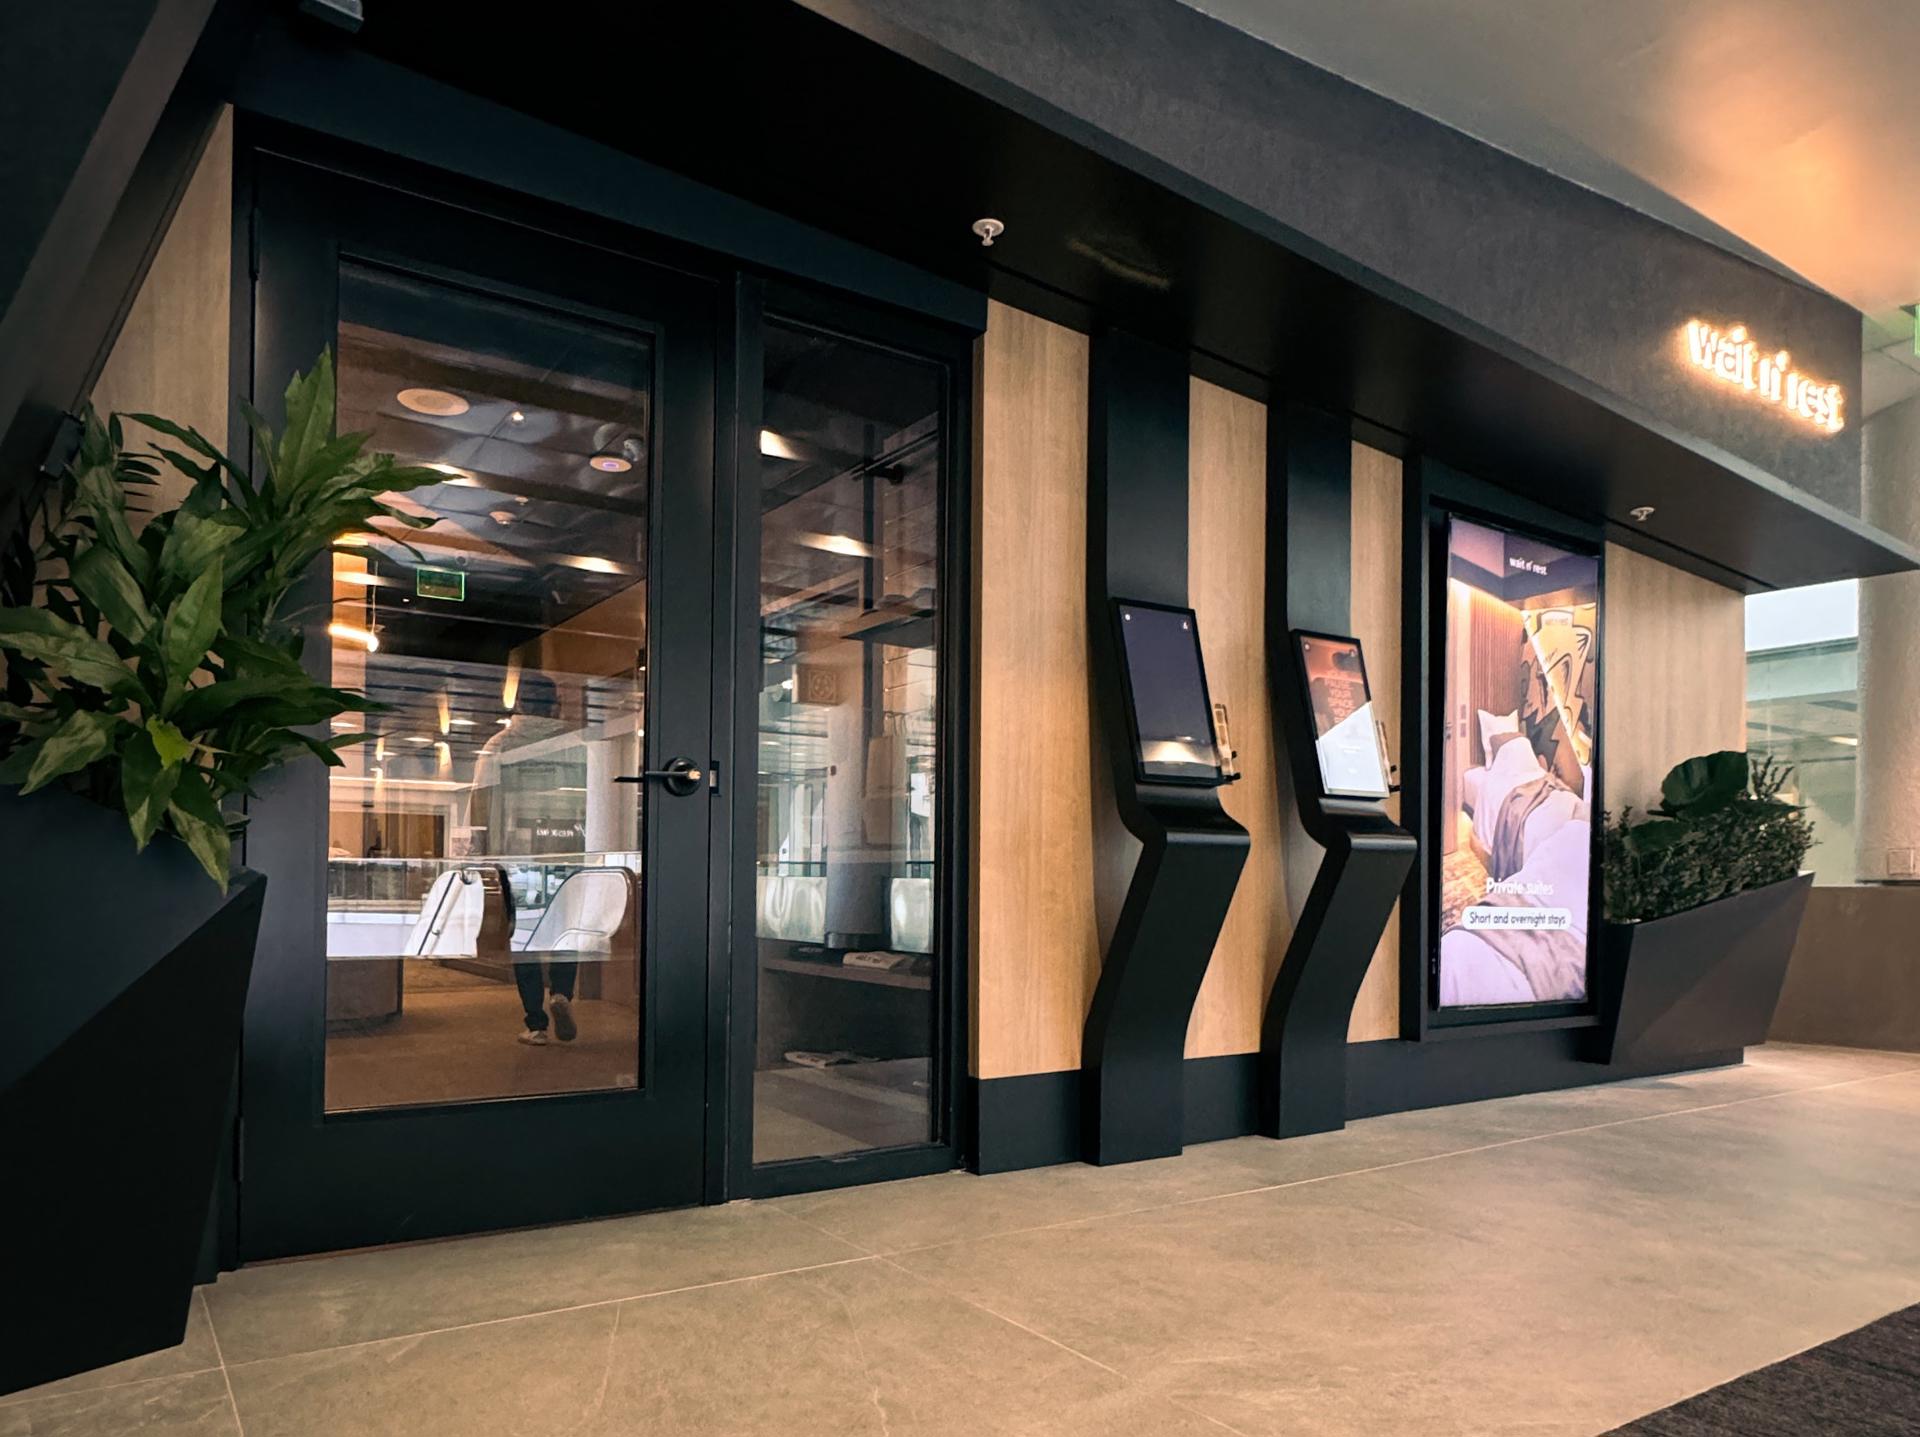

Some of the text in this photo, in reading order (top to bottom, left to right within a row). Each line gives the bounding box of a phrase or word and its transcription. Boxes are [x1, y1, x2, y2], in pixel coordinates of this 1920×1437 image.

[1687, 319, 1759, 390] wait
[1787, 373, 1845, 433] rest
[1510, 557, 1525, 569] wait
[1486, 877, 1553, 895] Private suites
[1470, 911, 1566, 927] Short and overnight stays
